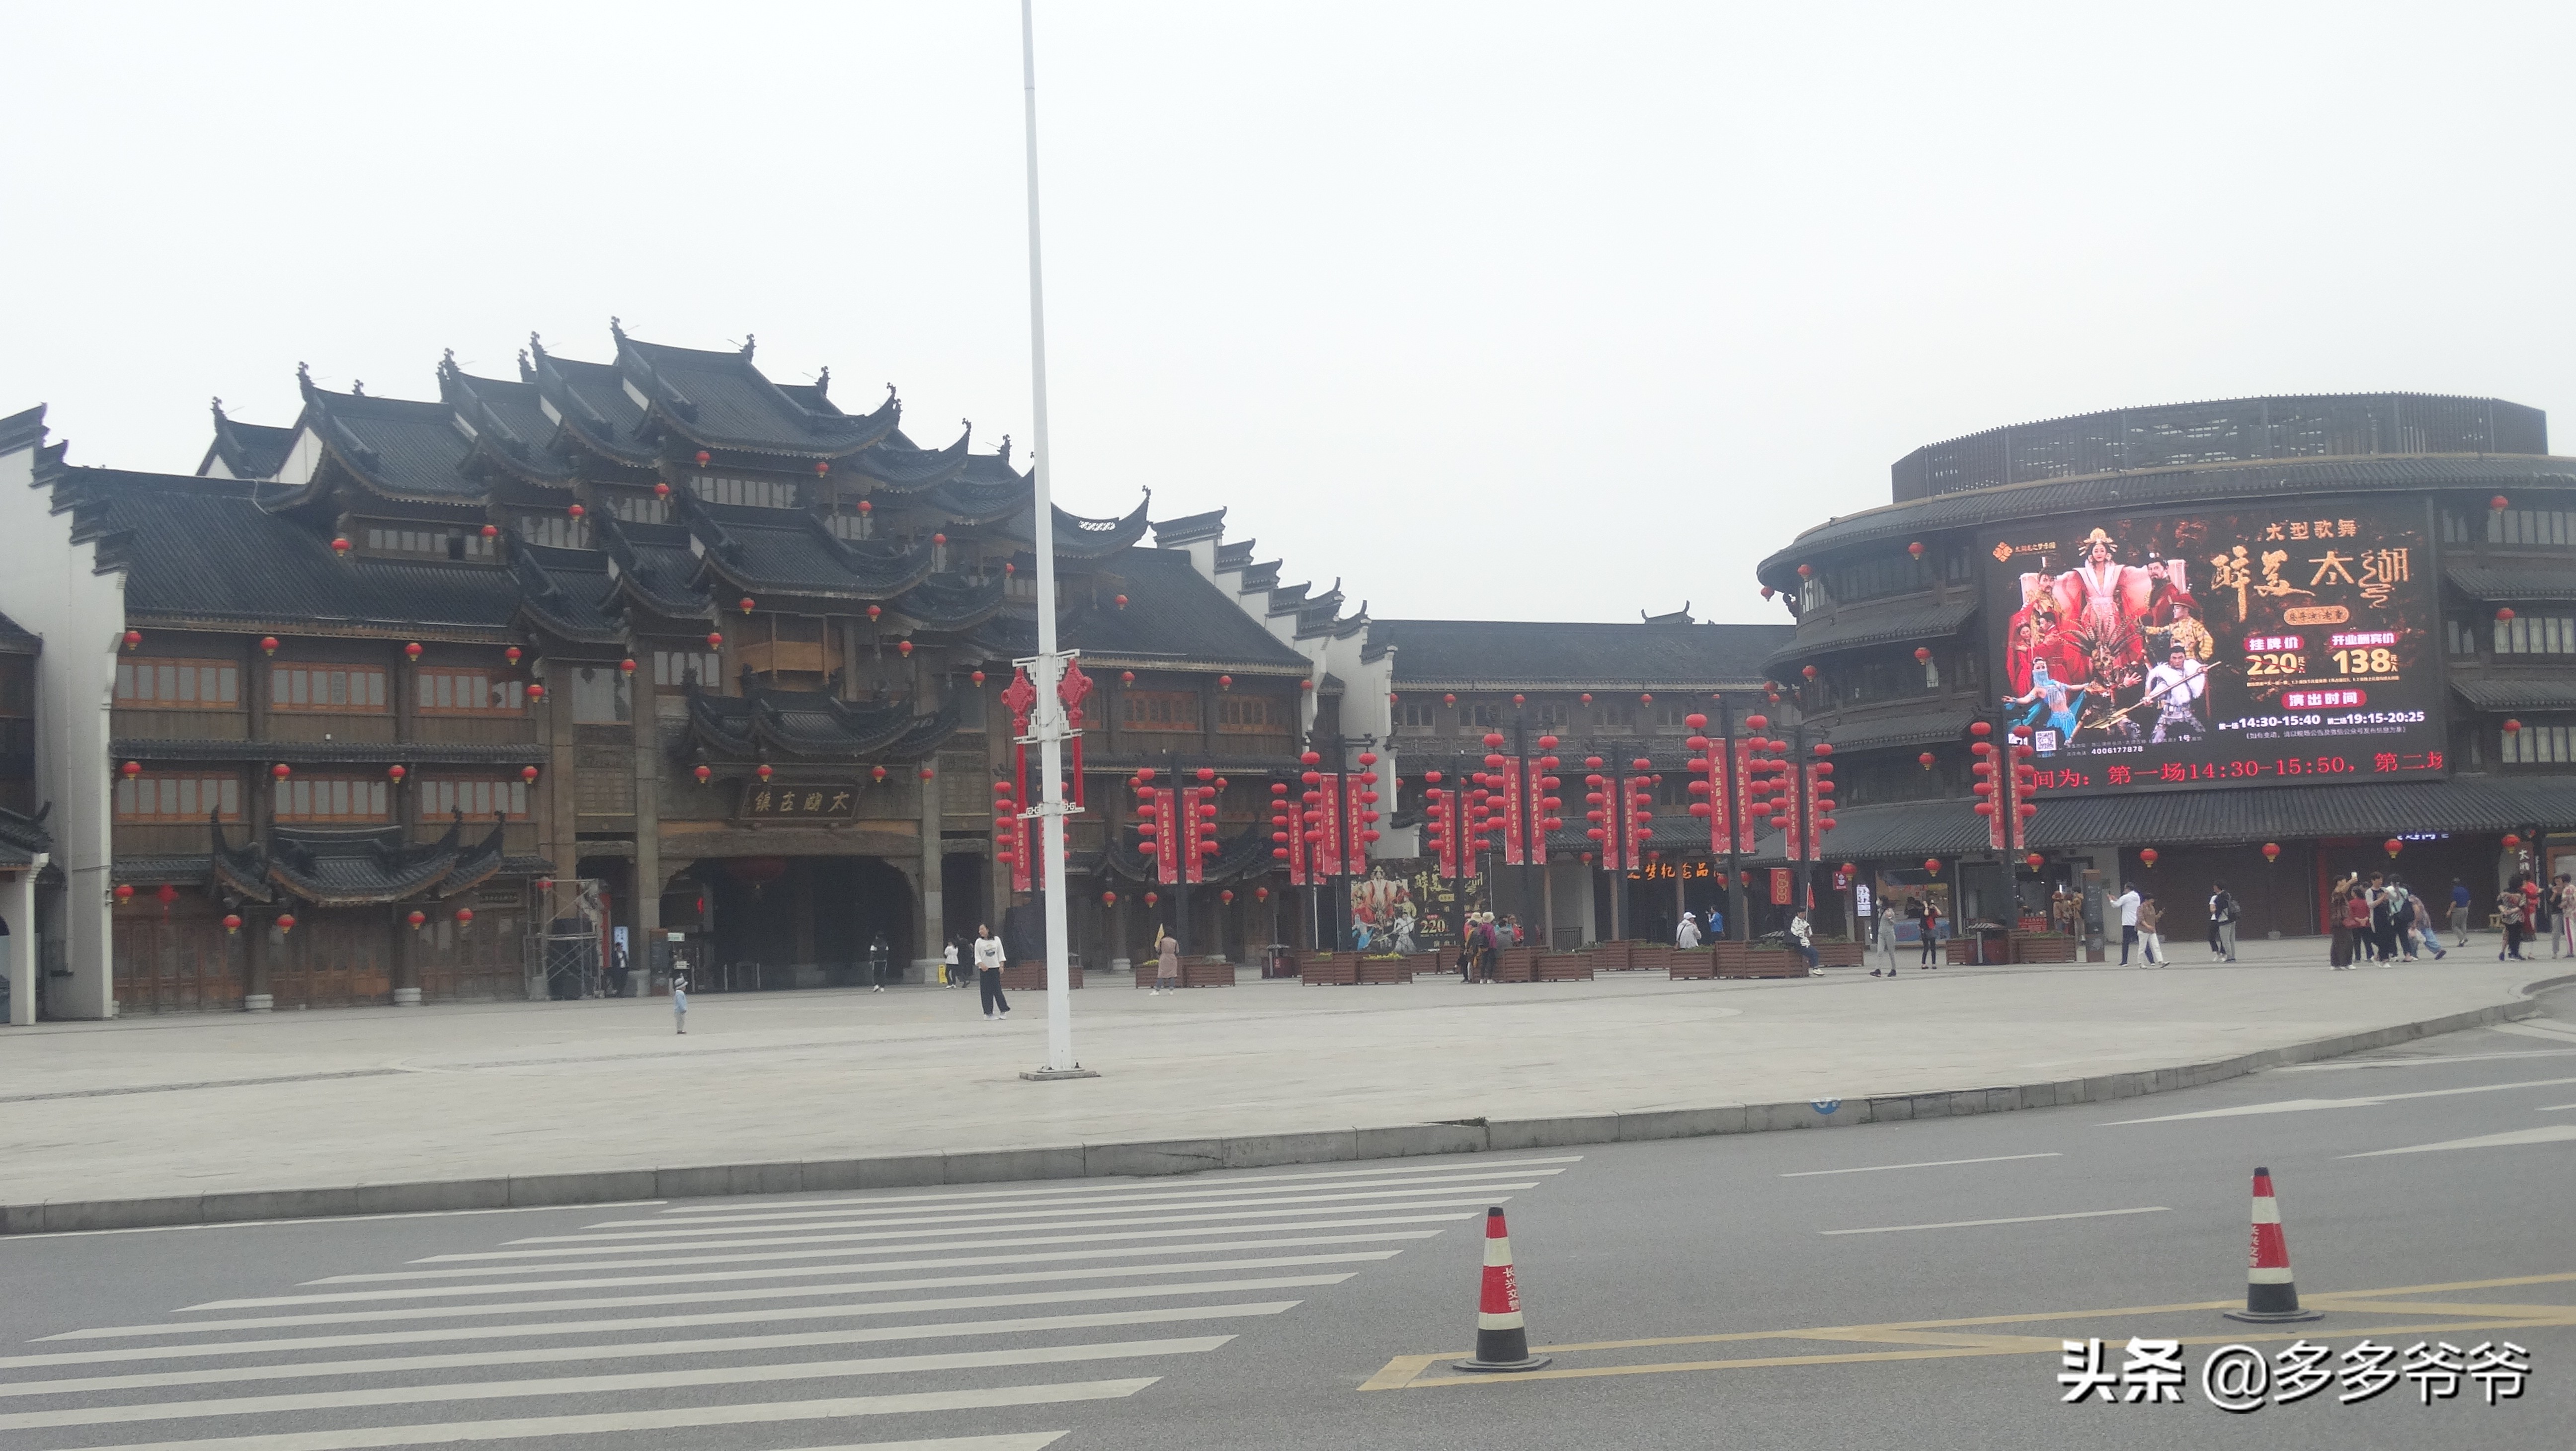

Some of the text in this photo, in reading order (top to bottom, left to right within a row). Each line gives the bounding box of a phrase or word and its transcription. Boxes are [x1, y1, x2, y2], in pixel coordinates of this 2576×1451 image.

[2266, 519, 2358, 541] 大型歌舞
[2210, 545, 2410, 623] 醉美太湖
[2249, 637, 2299, 650] 挂牌价
[2332, 633, 2395, 646] 开业酬宾价
[2332, 648, 2392, 674] 138
[2289, 692, 2357, 707] 演出时间
[2091, 746, 2143, 755] 4006177878
[1626, 862, 1725, 881] 之梦纪念品
[1502, 1267, 1520, 1311] 长兴交警
